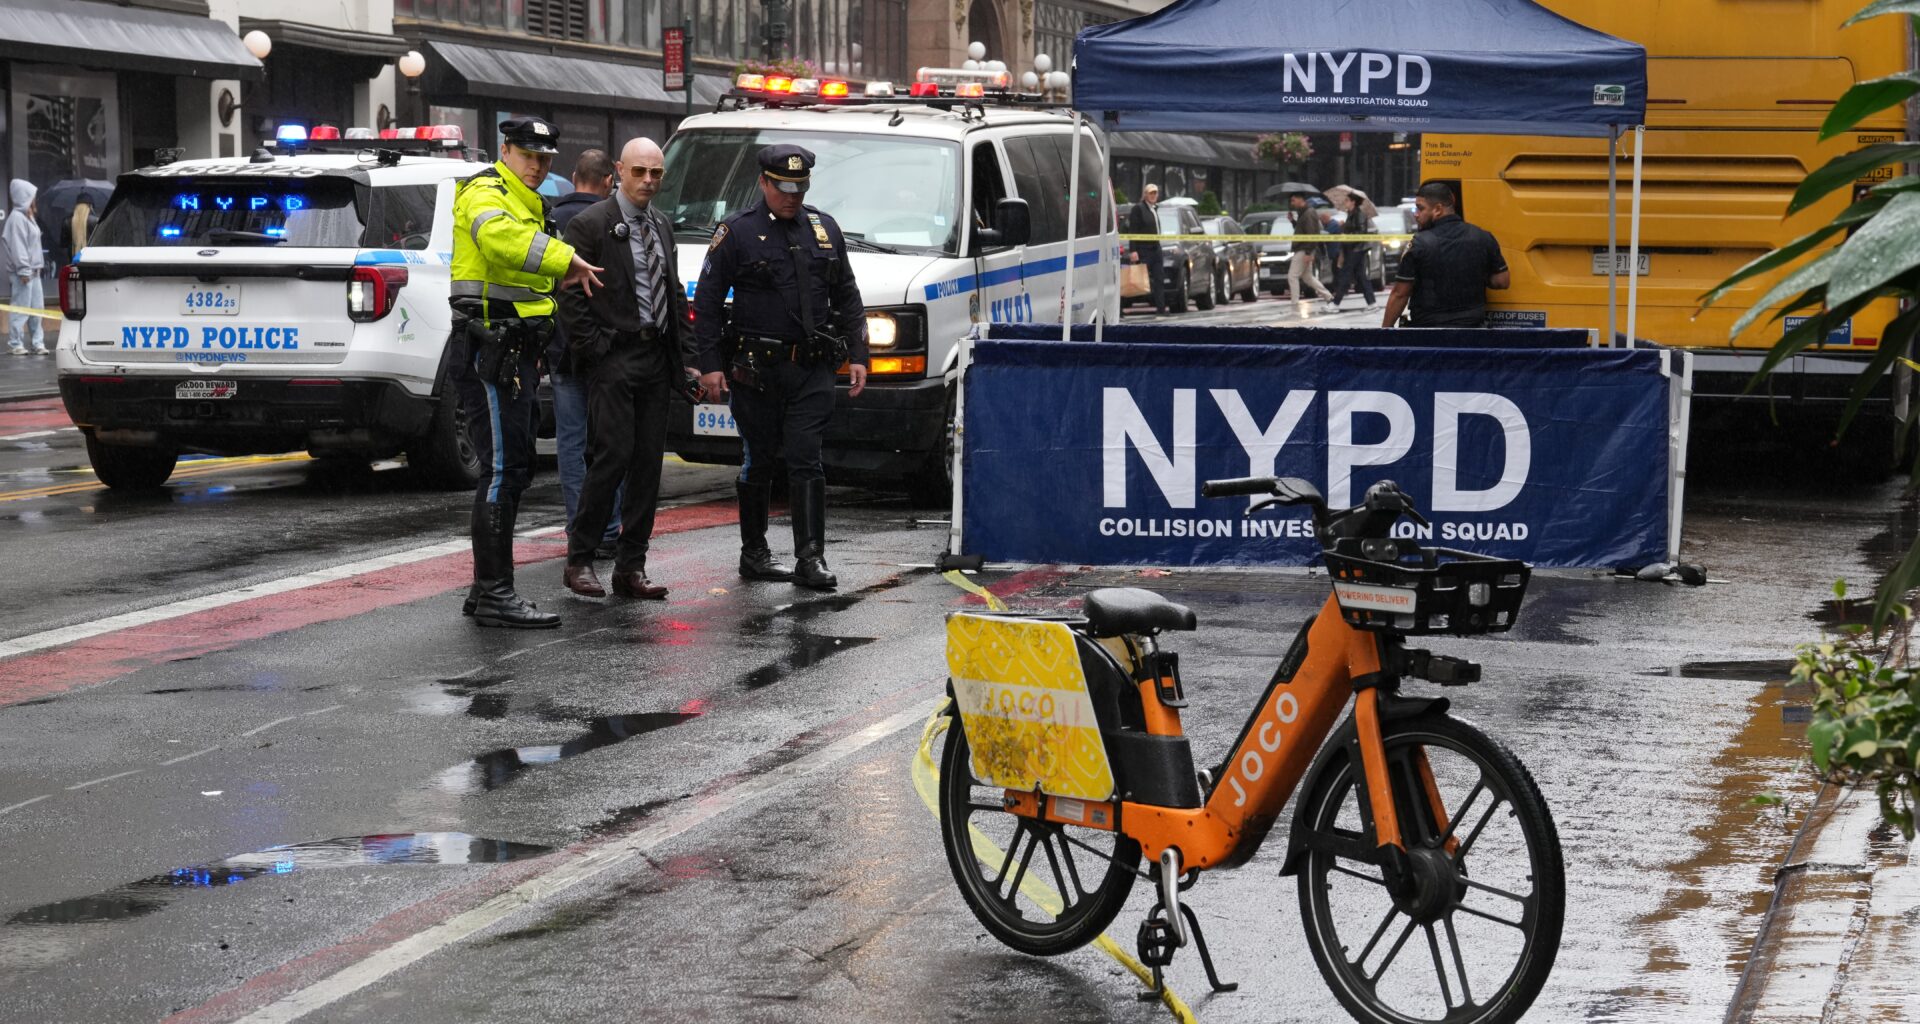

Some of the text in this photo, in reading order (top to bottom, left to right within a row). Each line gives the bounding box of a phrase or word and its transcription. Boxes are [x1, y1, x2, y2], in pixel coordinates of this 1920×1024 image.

[1283, 52, 1432, 95] NYPD
[1282, 95, 1429, 107] COLLISION INVESTIGATION SQUAD
[937, 279, 959, 299] POLICE
[186, 291, 236, 308] 4382 25
[1505, 312, 1517, 320] OF
[1517, 312, 1545, 320] BUSES
[121, 326, 299, 350] NYPD POLICE
[175, 352, 247, 362] @NYPDNEWS
[205, 381, 236, 389] REWARD
[1103, 387, 1531, 512] NYPD
[1099, 517, 1529, 541] COLLISION INVESION SQUAD
[1338, 590, 1409, 605] POWERING DELIVERY
[982, 687, 1055, 719] JOCO
[1228, 692, 1299, 807] JOCO
